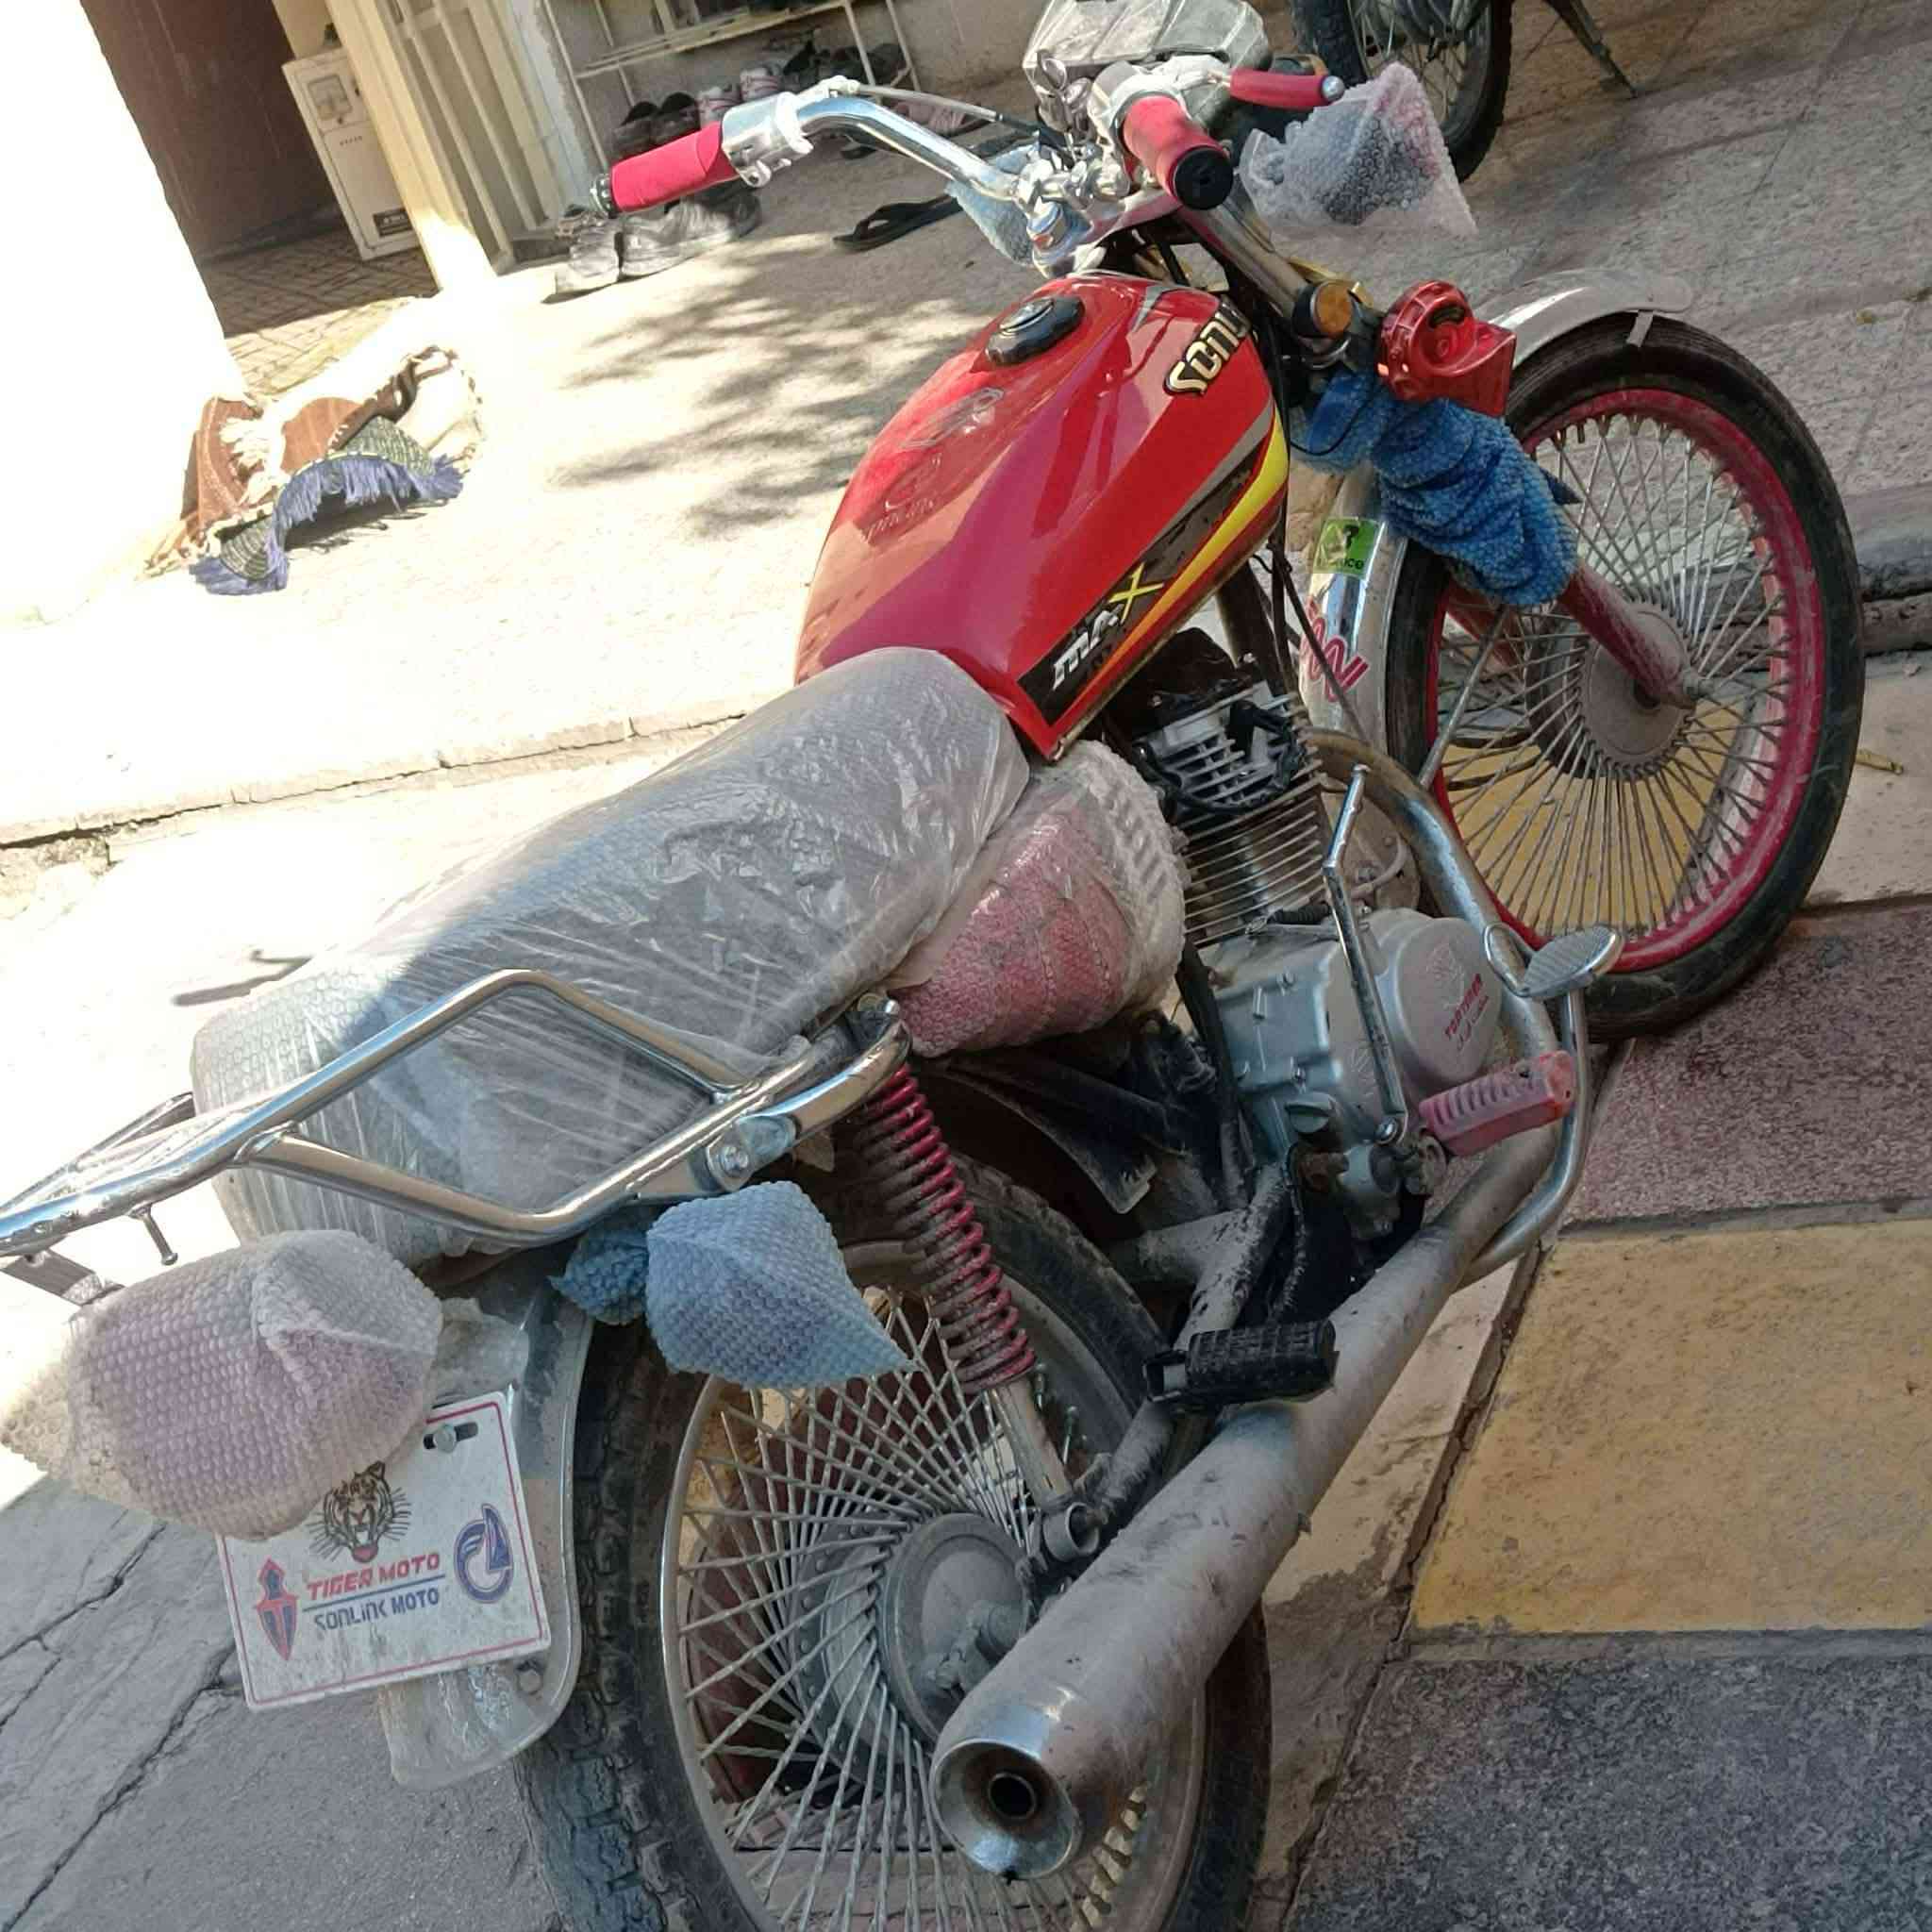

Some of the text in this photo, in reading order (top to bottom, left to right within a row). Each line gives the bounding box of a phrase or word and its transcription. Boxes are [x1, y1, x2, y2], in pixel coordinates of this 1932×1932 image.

[307, 1554, 440, 1601] TIGER MOTO
[391, 1588, 440, 1615] MOTO
